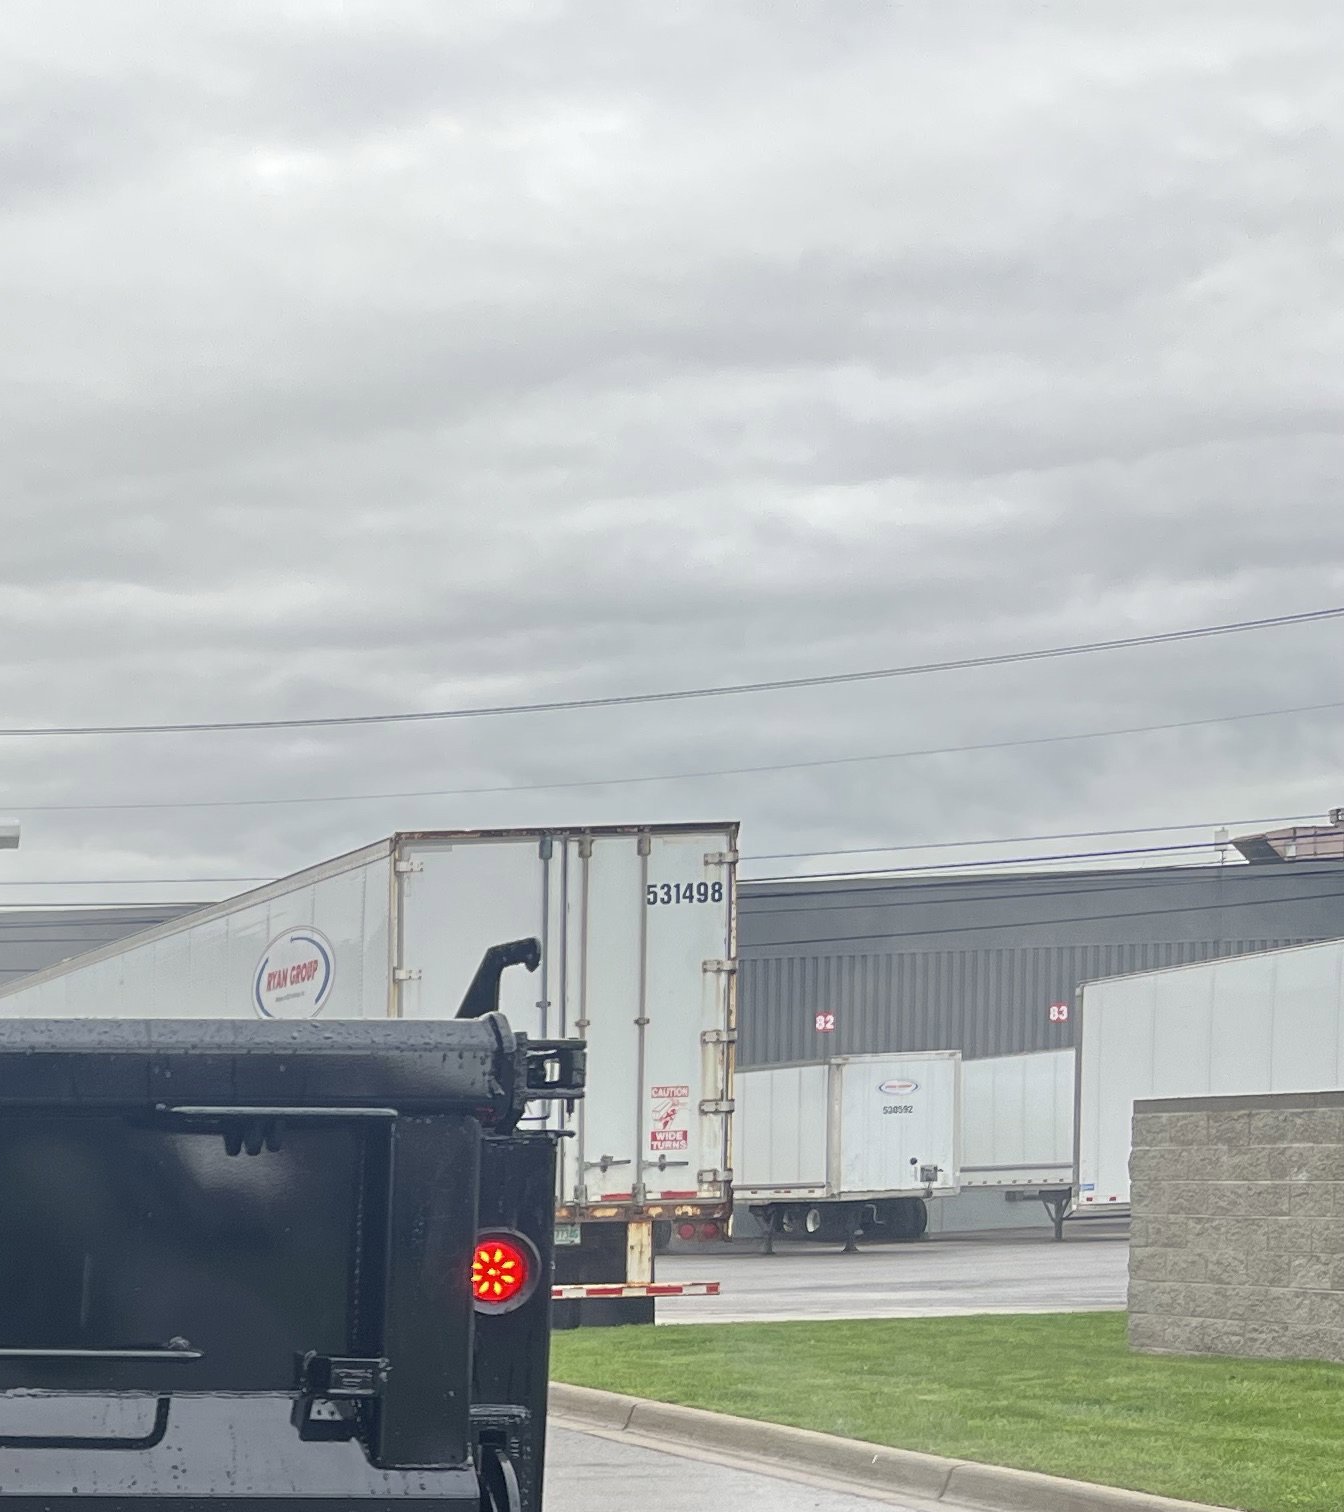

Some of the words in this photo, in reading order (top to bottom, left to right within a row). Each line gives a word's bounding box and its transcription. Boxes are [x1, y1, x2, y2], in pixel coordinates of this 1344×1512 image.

[647, 881, 723, 905] 531498
[266, 968, 289, 992] RYAN
[290, 959, 319, 986] GROUP
[1049, 1005, 1068, 1021] 83
[815, 1014, 835, 1030] 82
[652, 1087, 688, 1097] CAUTION
[656, 1131, 683, 1141] WIDE
[651, 1140, 687, 1150] TURNS
